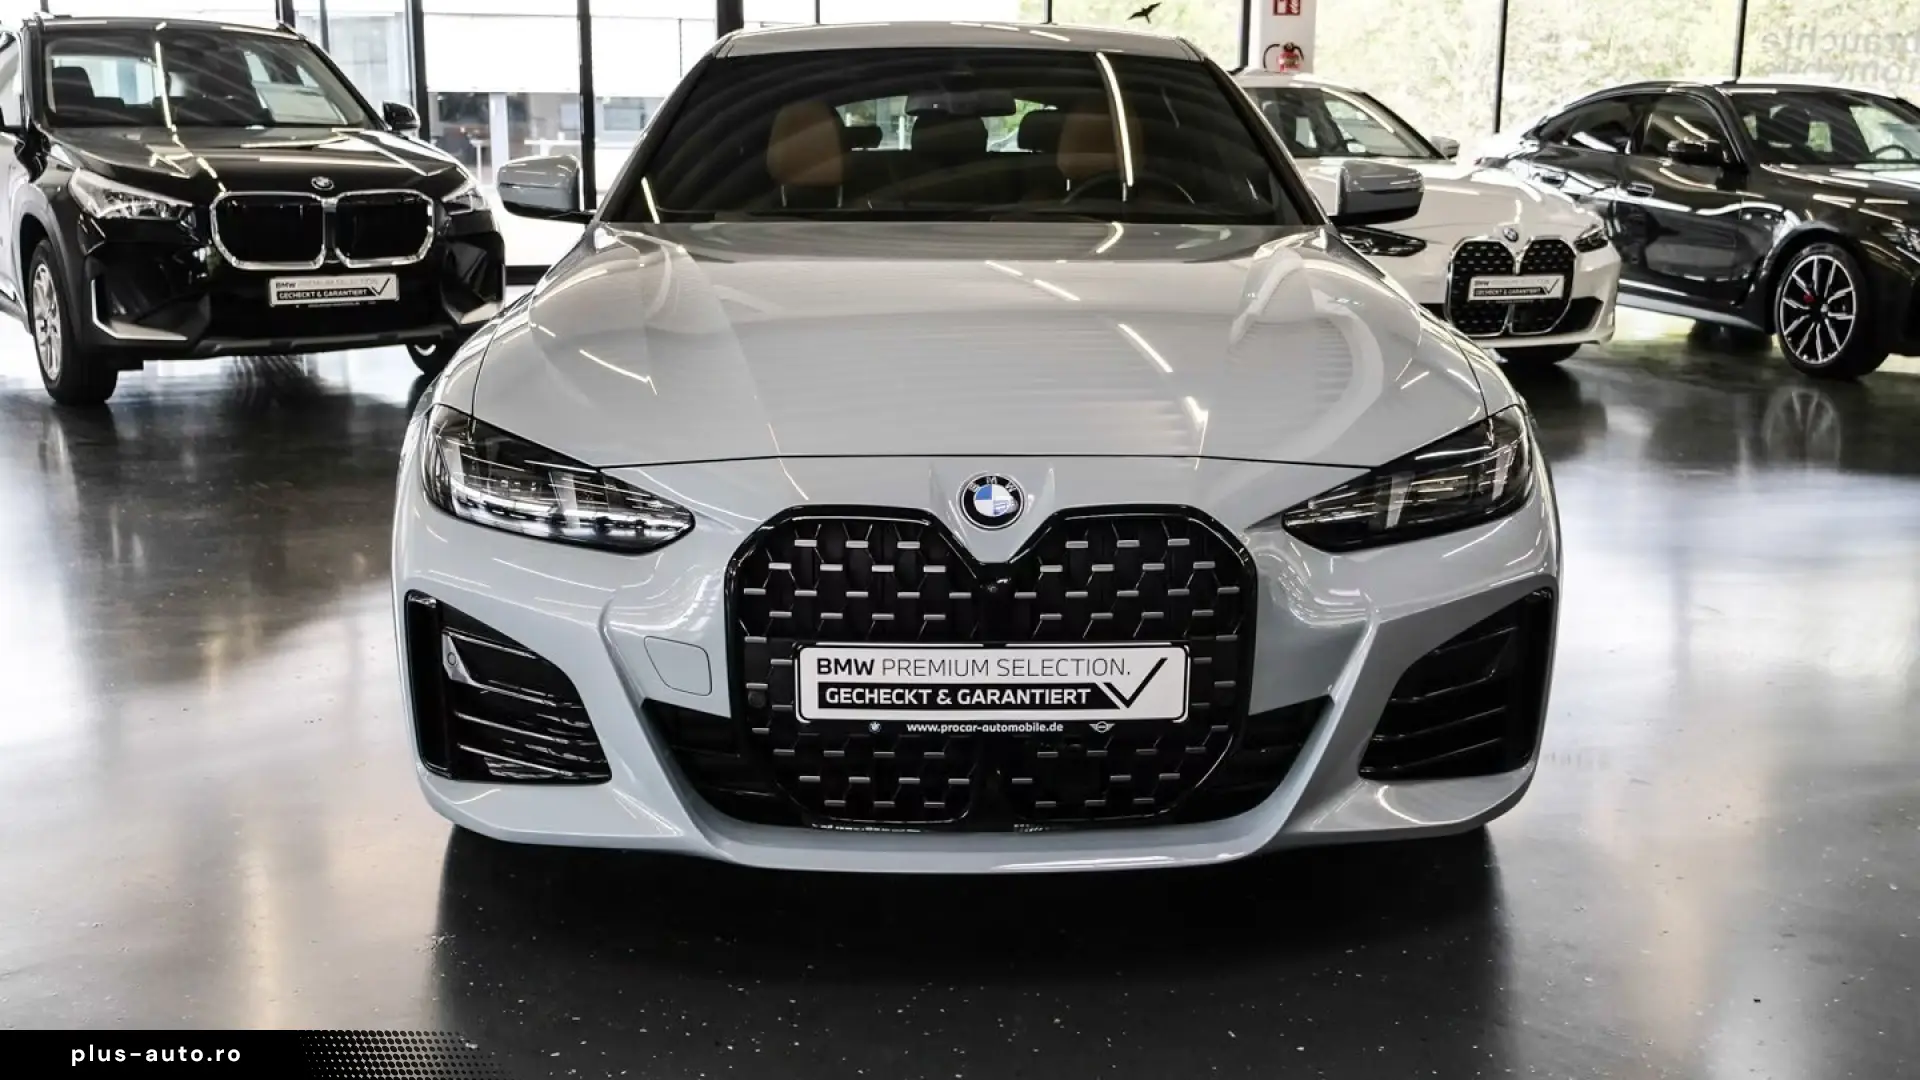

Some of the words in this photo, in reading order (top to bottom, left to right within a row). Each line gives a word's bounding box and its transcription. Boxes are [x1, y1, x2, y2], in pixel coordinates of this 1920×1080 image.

[275, 281, 297, 289] BMW
[817, 658, 875, 676] BMW
[882, 658, 989, 677] PREMIUM
[996, 658, 1131, 677] SELECTION.
[825, 687, 933, 705] GECHECKT
[936, 688, 953, 705] &
[957, 688, 1092, 705] GARANTIERT
[906, 722, 1064, 734] www.procar-automobile.de
